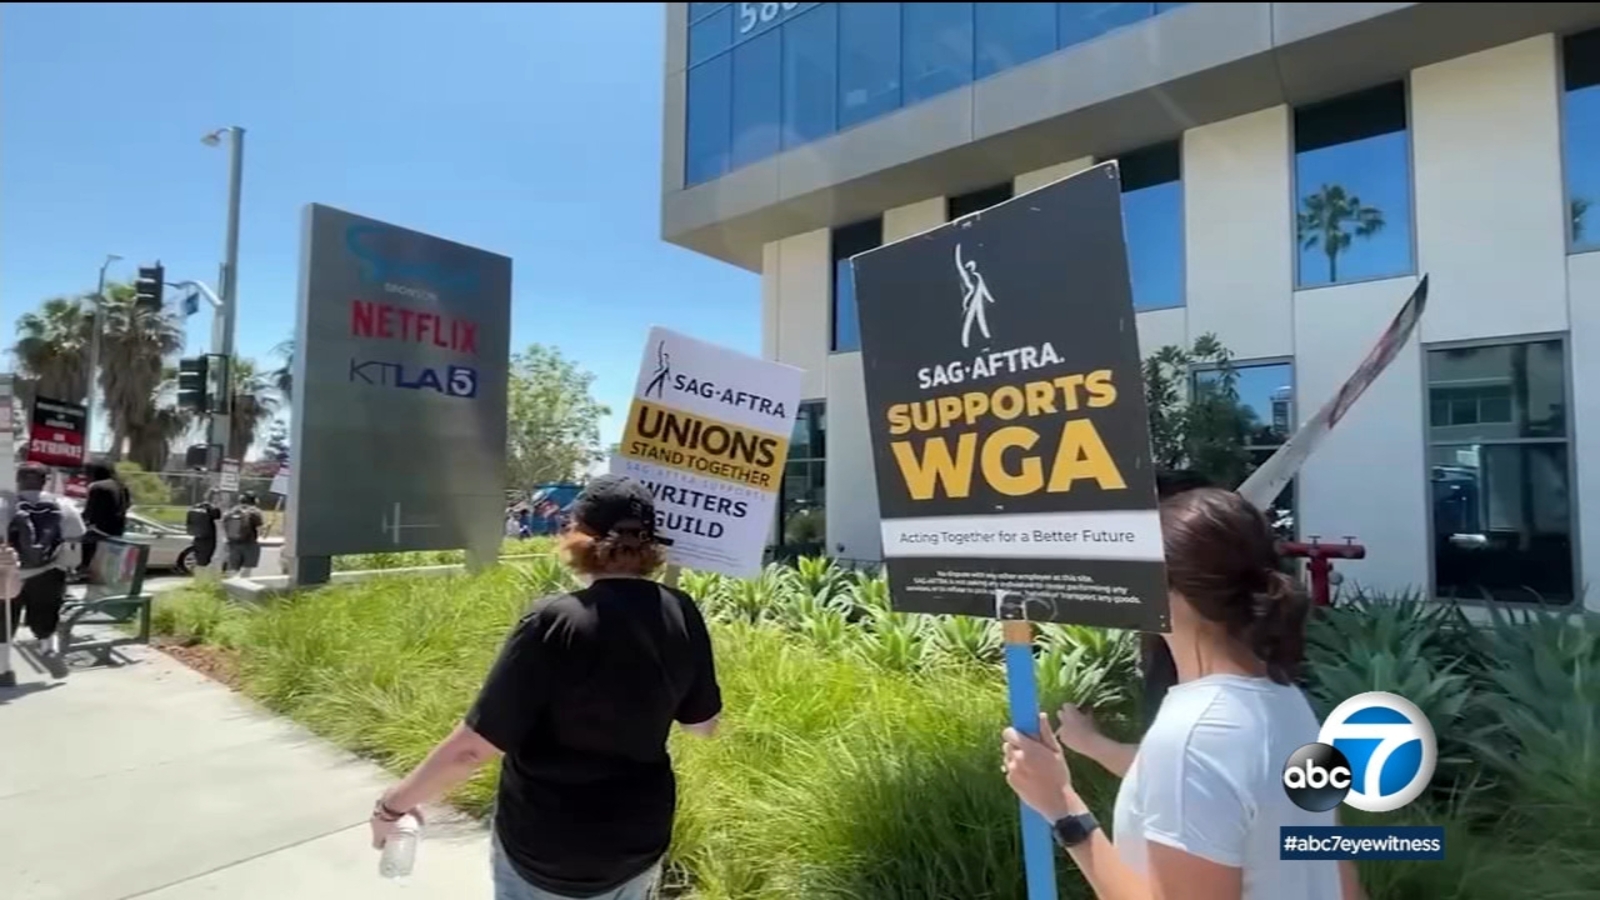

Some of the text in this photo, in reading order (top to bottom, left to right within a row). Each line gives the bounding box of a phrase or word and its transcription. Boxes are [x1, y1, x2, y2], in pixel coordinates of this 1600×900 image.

[740, 3, 798, 34] 58
[352, 300, 477, 353] NETFLIX
[887, 370, 1117, 434] SUPPORTS
[637, 406, 777, 467] UNIONS
[890, 419, 1128, 500] WGA
[630, 441, 771, 487] STAND TOGETHER
[900, 529, 1135, 545] Acting Together for a Better Future
